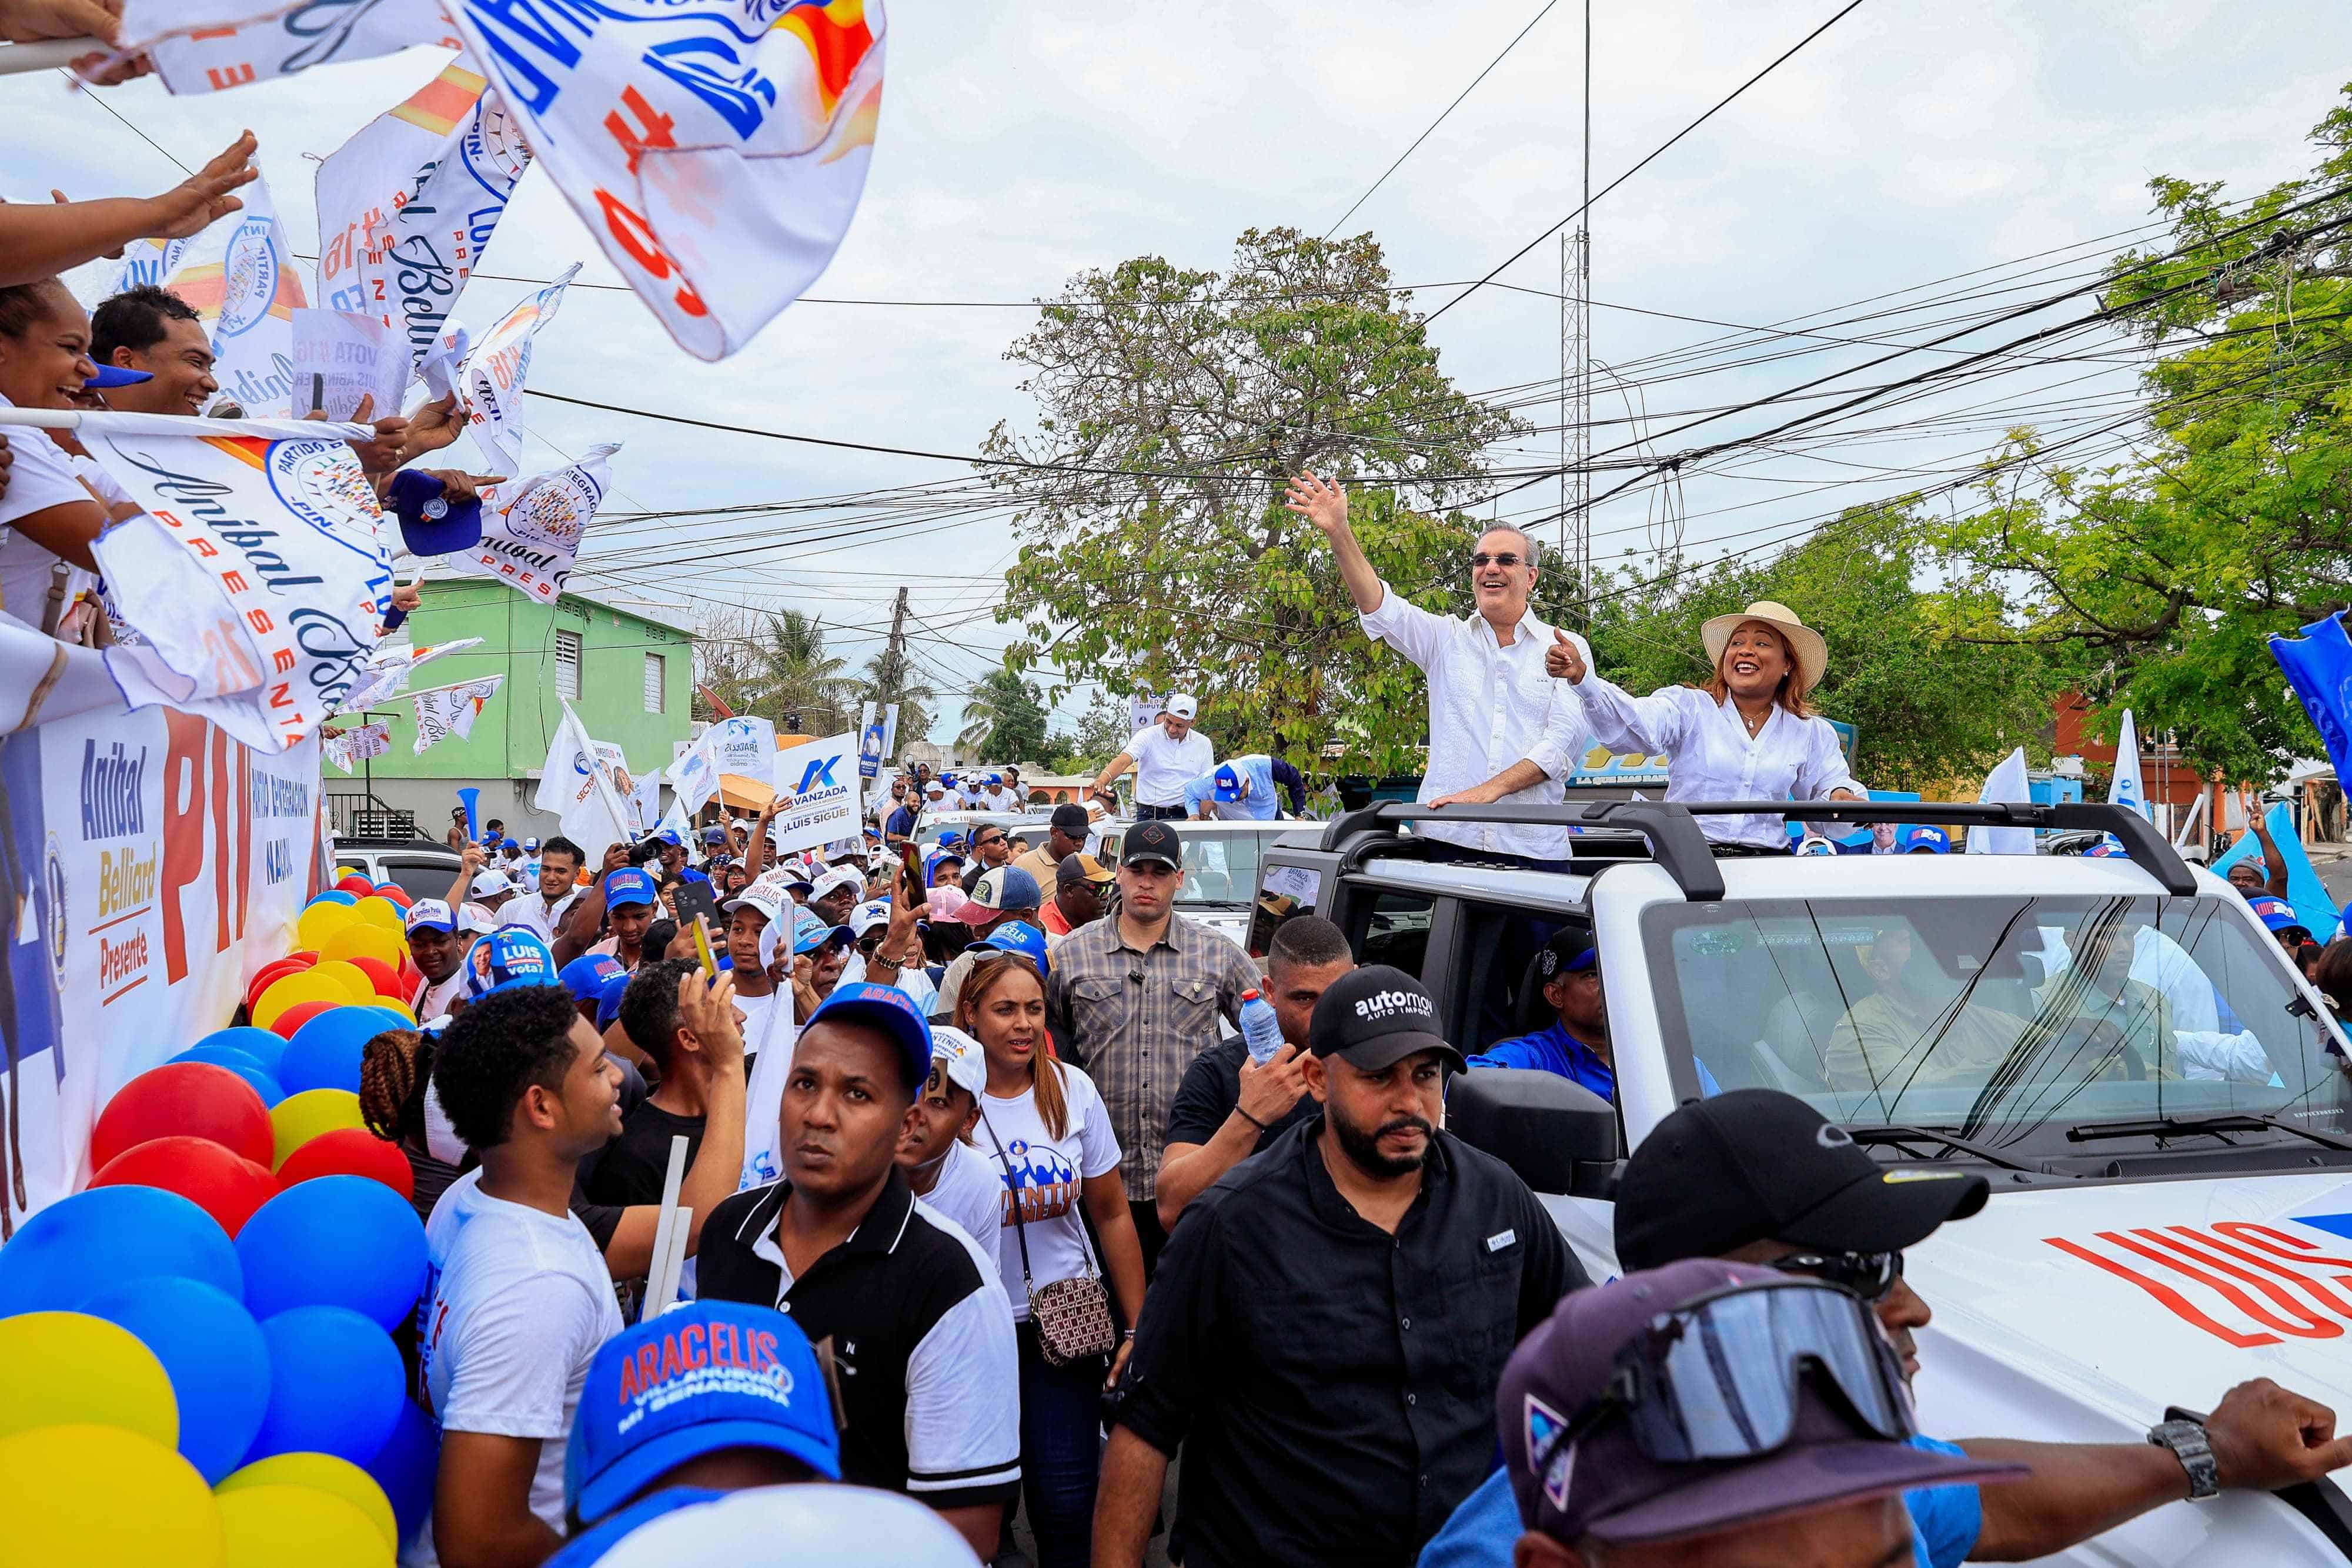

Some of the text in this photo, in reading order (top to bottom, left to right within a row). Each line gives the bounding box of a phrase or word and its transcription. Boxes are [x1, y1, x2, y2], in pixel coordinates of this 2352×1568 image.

[81, 738, 148, 841] Anibal
[784, 807, 850, 834] ¡LUIS SIGUE!
[99, 841, 157, 918] Belliard
[99, 927, 148, 989] Presente
[502, 944, 542, 959] LUIS
[1355, 990, 1434, 1017] automov
[1367, 1007, 1431, 1022] AUTO IMPORT
[2043, 1221, 2352, 1348] LUIS
[619, 1322, 779, 1405] ARACELIS
